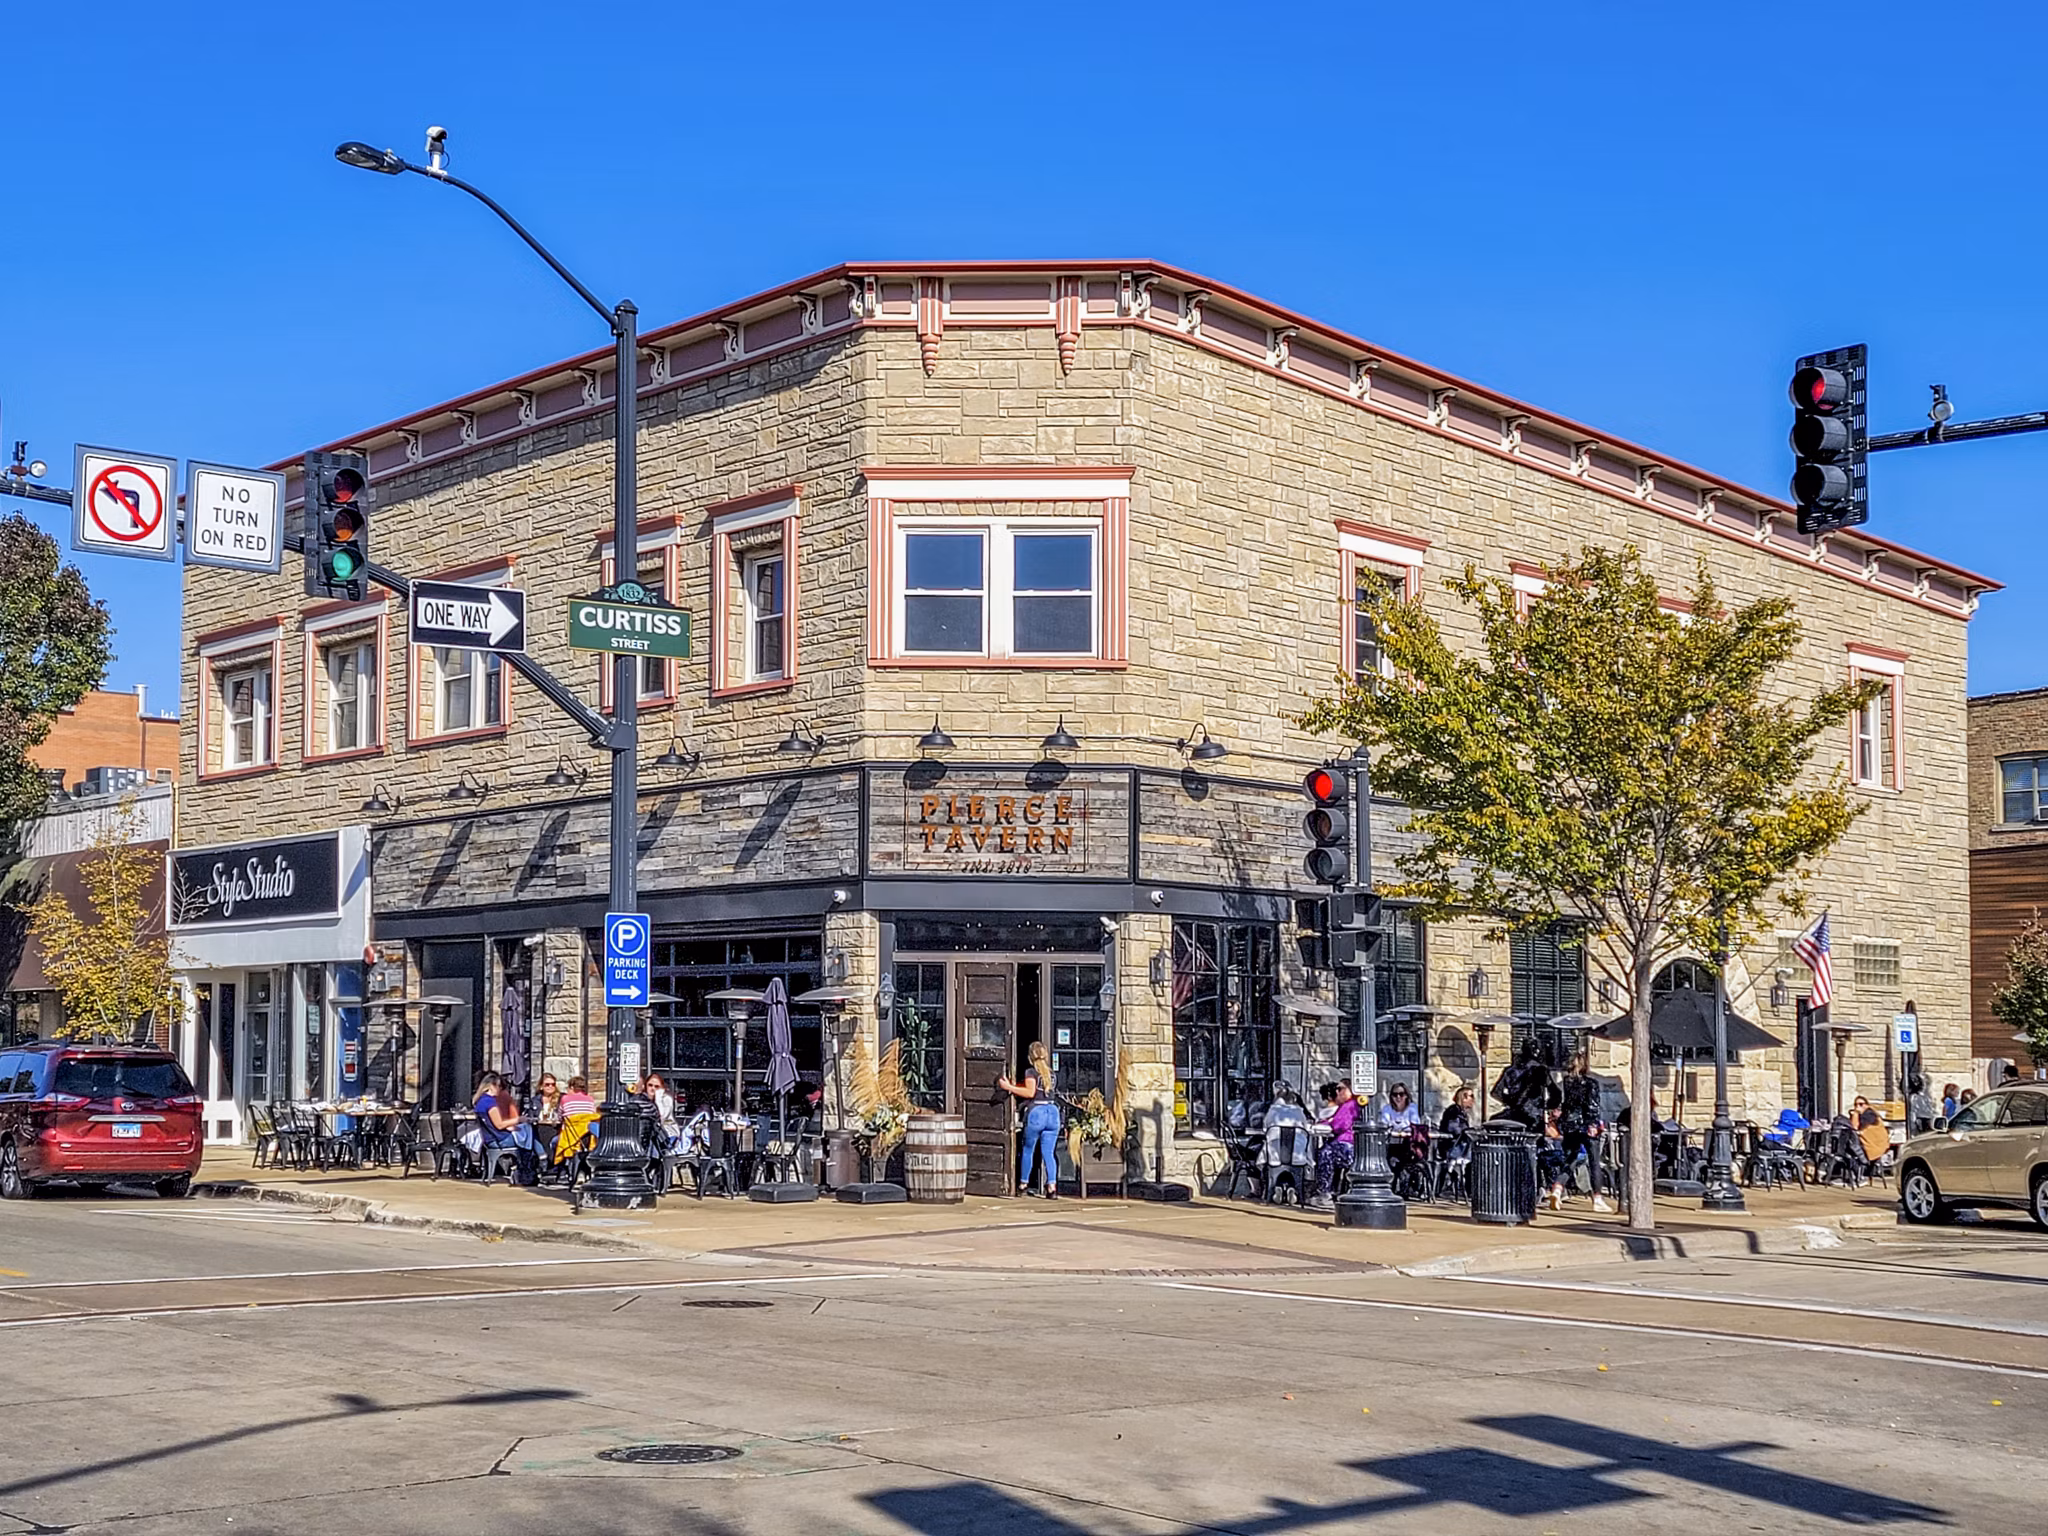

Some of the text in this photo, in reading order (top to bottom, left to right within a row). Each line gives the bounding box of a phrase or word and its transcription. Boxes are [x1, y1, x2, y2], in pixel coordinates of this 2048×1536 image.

[222, 485, 251, 503] NO
[213, 507, 259, 528] TURN
[201, 529, 267, 551] ON RED
[424, 602, 492, 629] ONE WAY
[579, 606, 682, 636] CURTISS
[610, 637, 651, 650] STREET
[921, 794, 1074, 819] PIERCE
[920, 824, 1074, 848] TAVERN
[207, 854, 296, 917] Style Studio
[618, 924, 637, 949] P
[608, 957, 646, 968] PARKING
[615, 969, 639, 980] DECK
